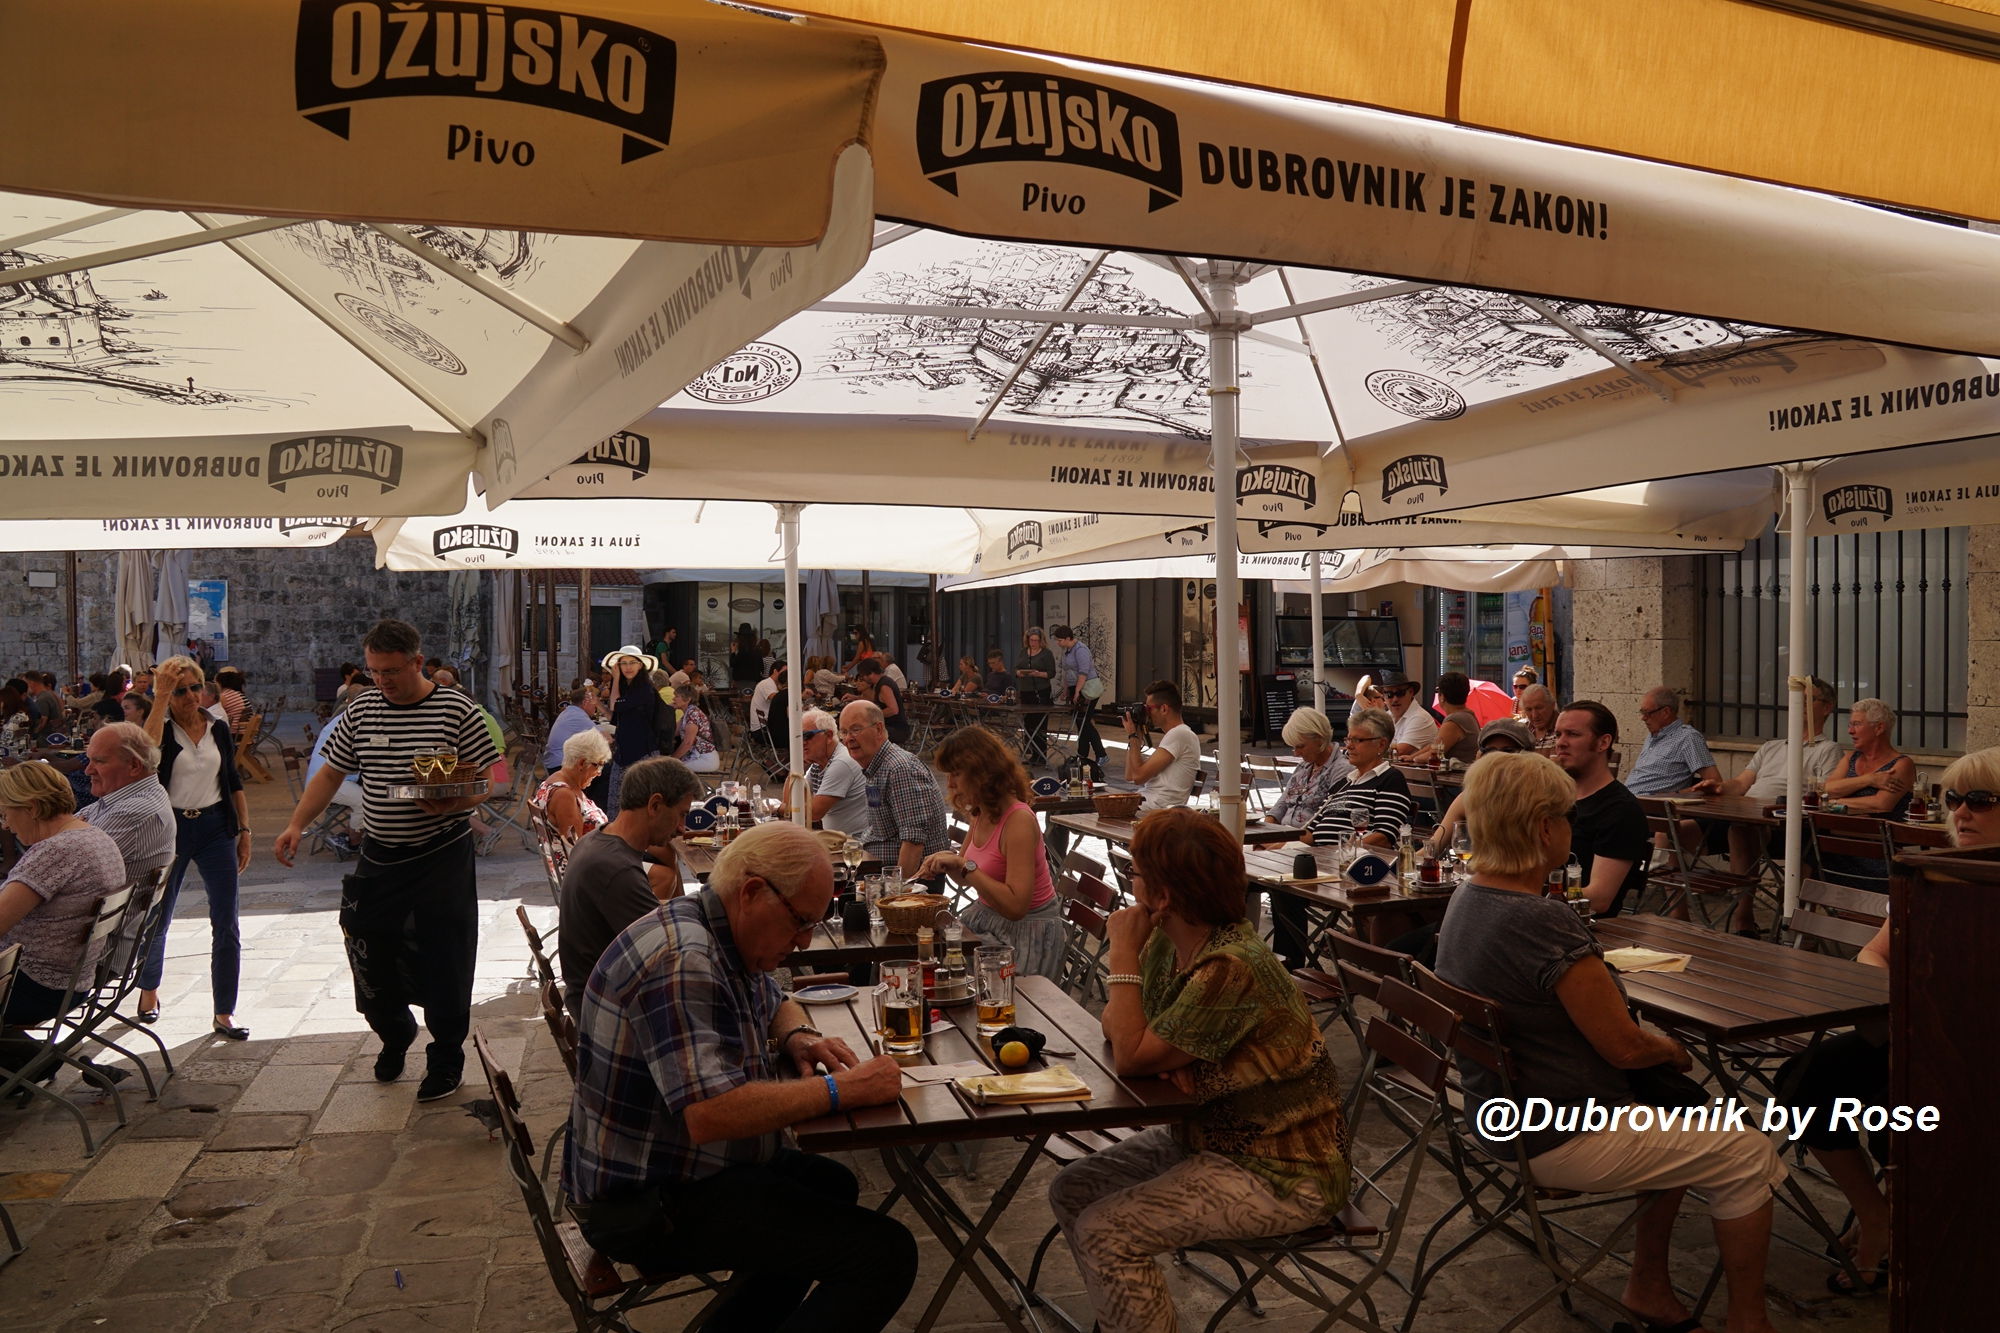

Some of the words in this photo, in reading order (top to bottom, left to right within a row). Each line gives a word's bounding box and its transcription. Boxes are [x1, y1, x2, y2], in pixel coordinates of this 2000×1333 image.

[331, 2, 648, 116] Ožujsko
[941, 79, 1163, 173] Ožujsko
[447, 124, 536, 167] Pivo
[1022, 182, 1086, 215] Pivo
[1199, 142, 1426, 214] DUBROVNIK
[1440, 175, 1476, 221] JE
[1490, 184, 1609, 240] ZAKON!
[1285, 531, 1302, 541] Pivo
[1042, 783, 1051, 791] 23
[694, 816, 702, 824] 17
[1363, 865, 1374, 877] 21
